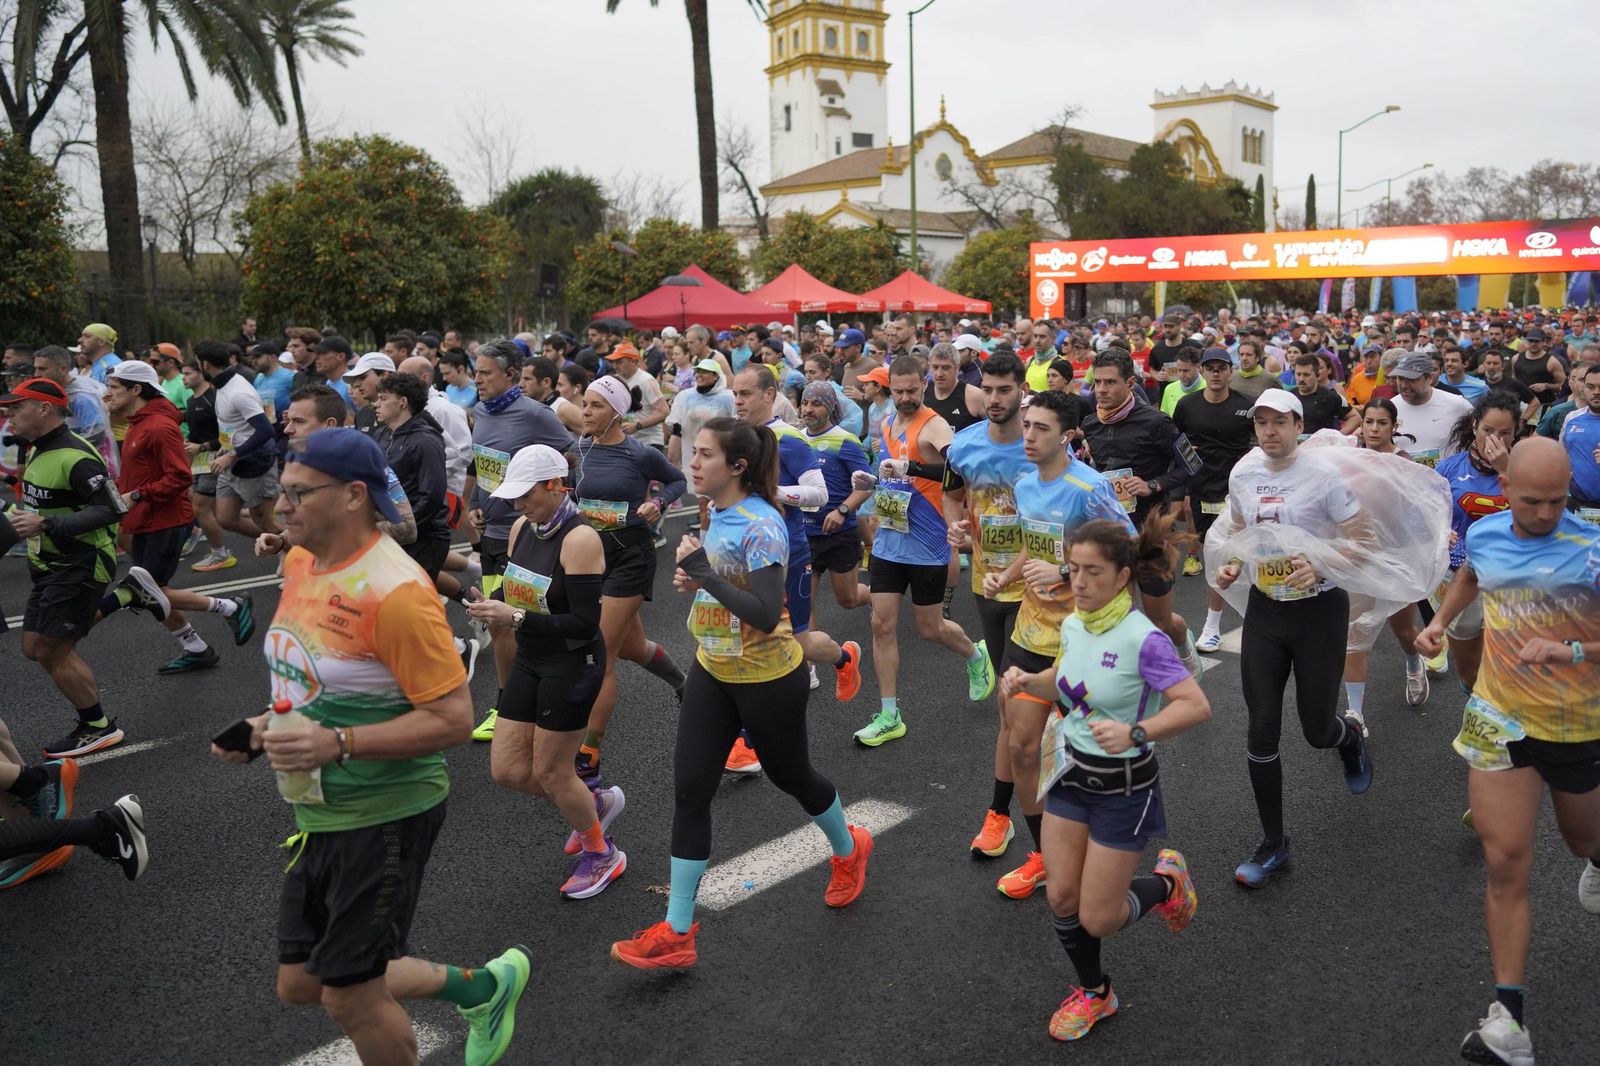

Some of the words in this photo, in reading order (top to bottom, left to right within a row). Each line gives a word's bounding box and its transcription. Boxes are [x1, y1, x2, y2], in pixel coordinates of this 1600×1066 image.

[1452, 238, 1509, 257] HOKA
[475, 456, 501, 477] 13232
[985, 527, 1023, 545] 12541
[1024, 533, 1055, 556] 12540
[507, 580, 536, 606] 9482
[695, 605, 731, 628] 12150
[1465, 712, 1499, 741] 8952
